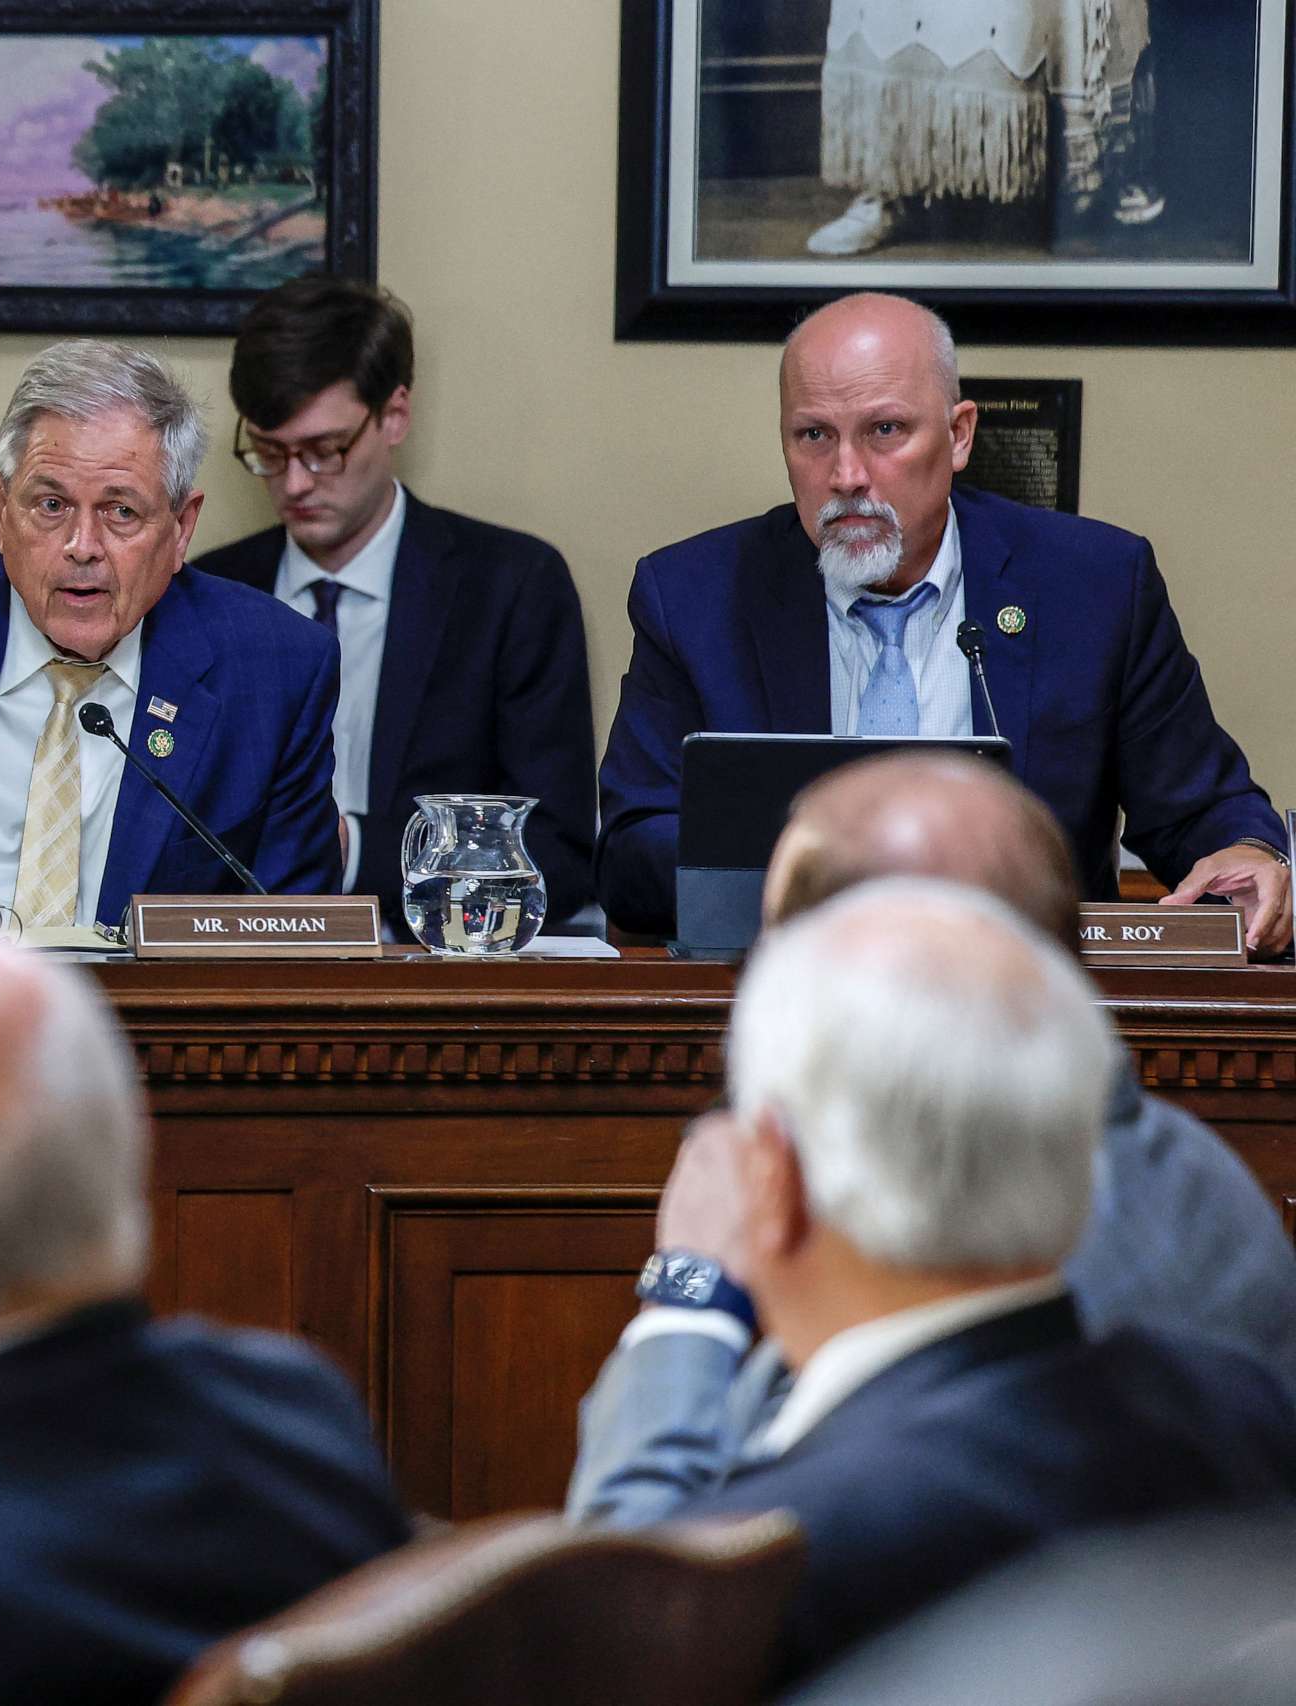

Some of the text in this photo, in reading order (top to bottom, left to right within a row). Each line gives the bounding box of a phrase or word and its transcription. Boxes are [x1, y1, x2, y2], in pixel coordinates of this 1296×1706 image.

[193, 917, 326, 933] MR. NORMAN
[1079, 926, 1165, 940] MR. ROY
